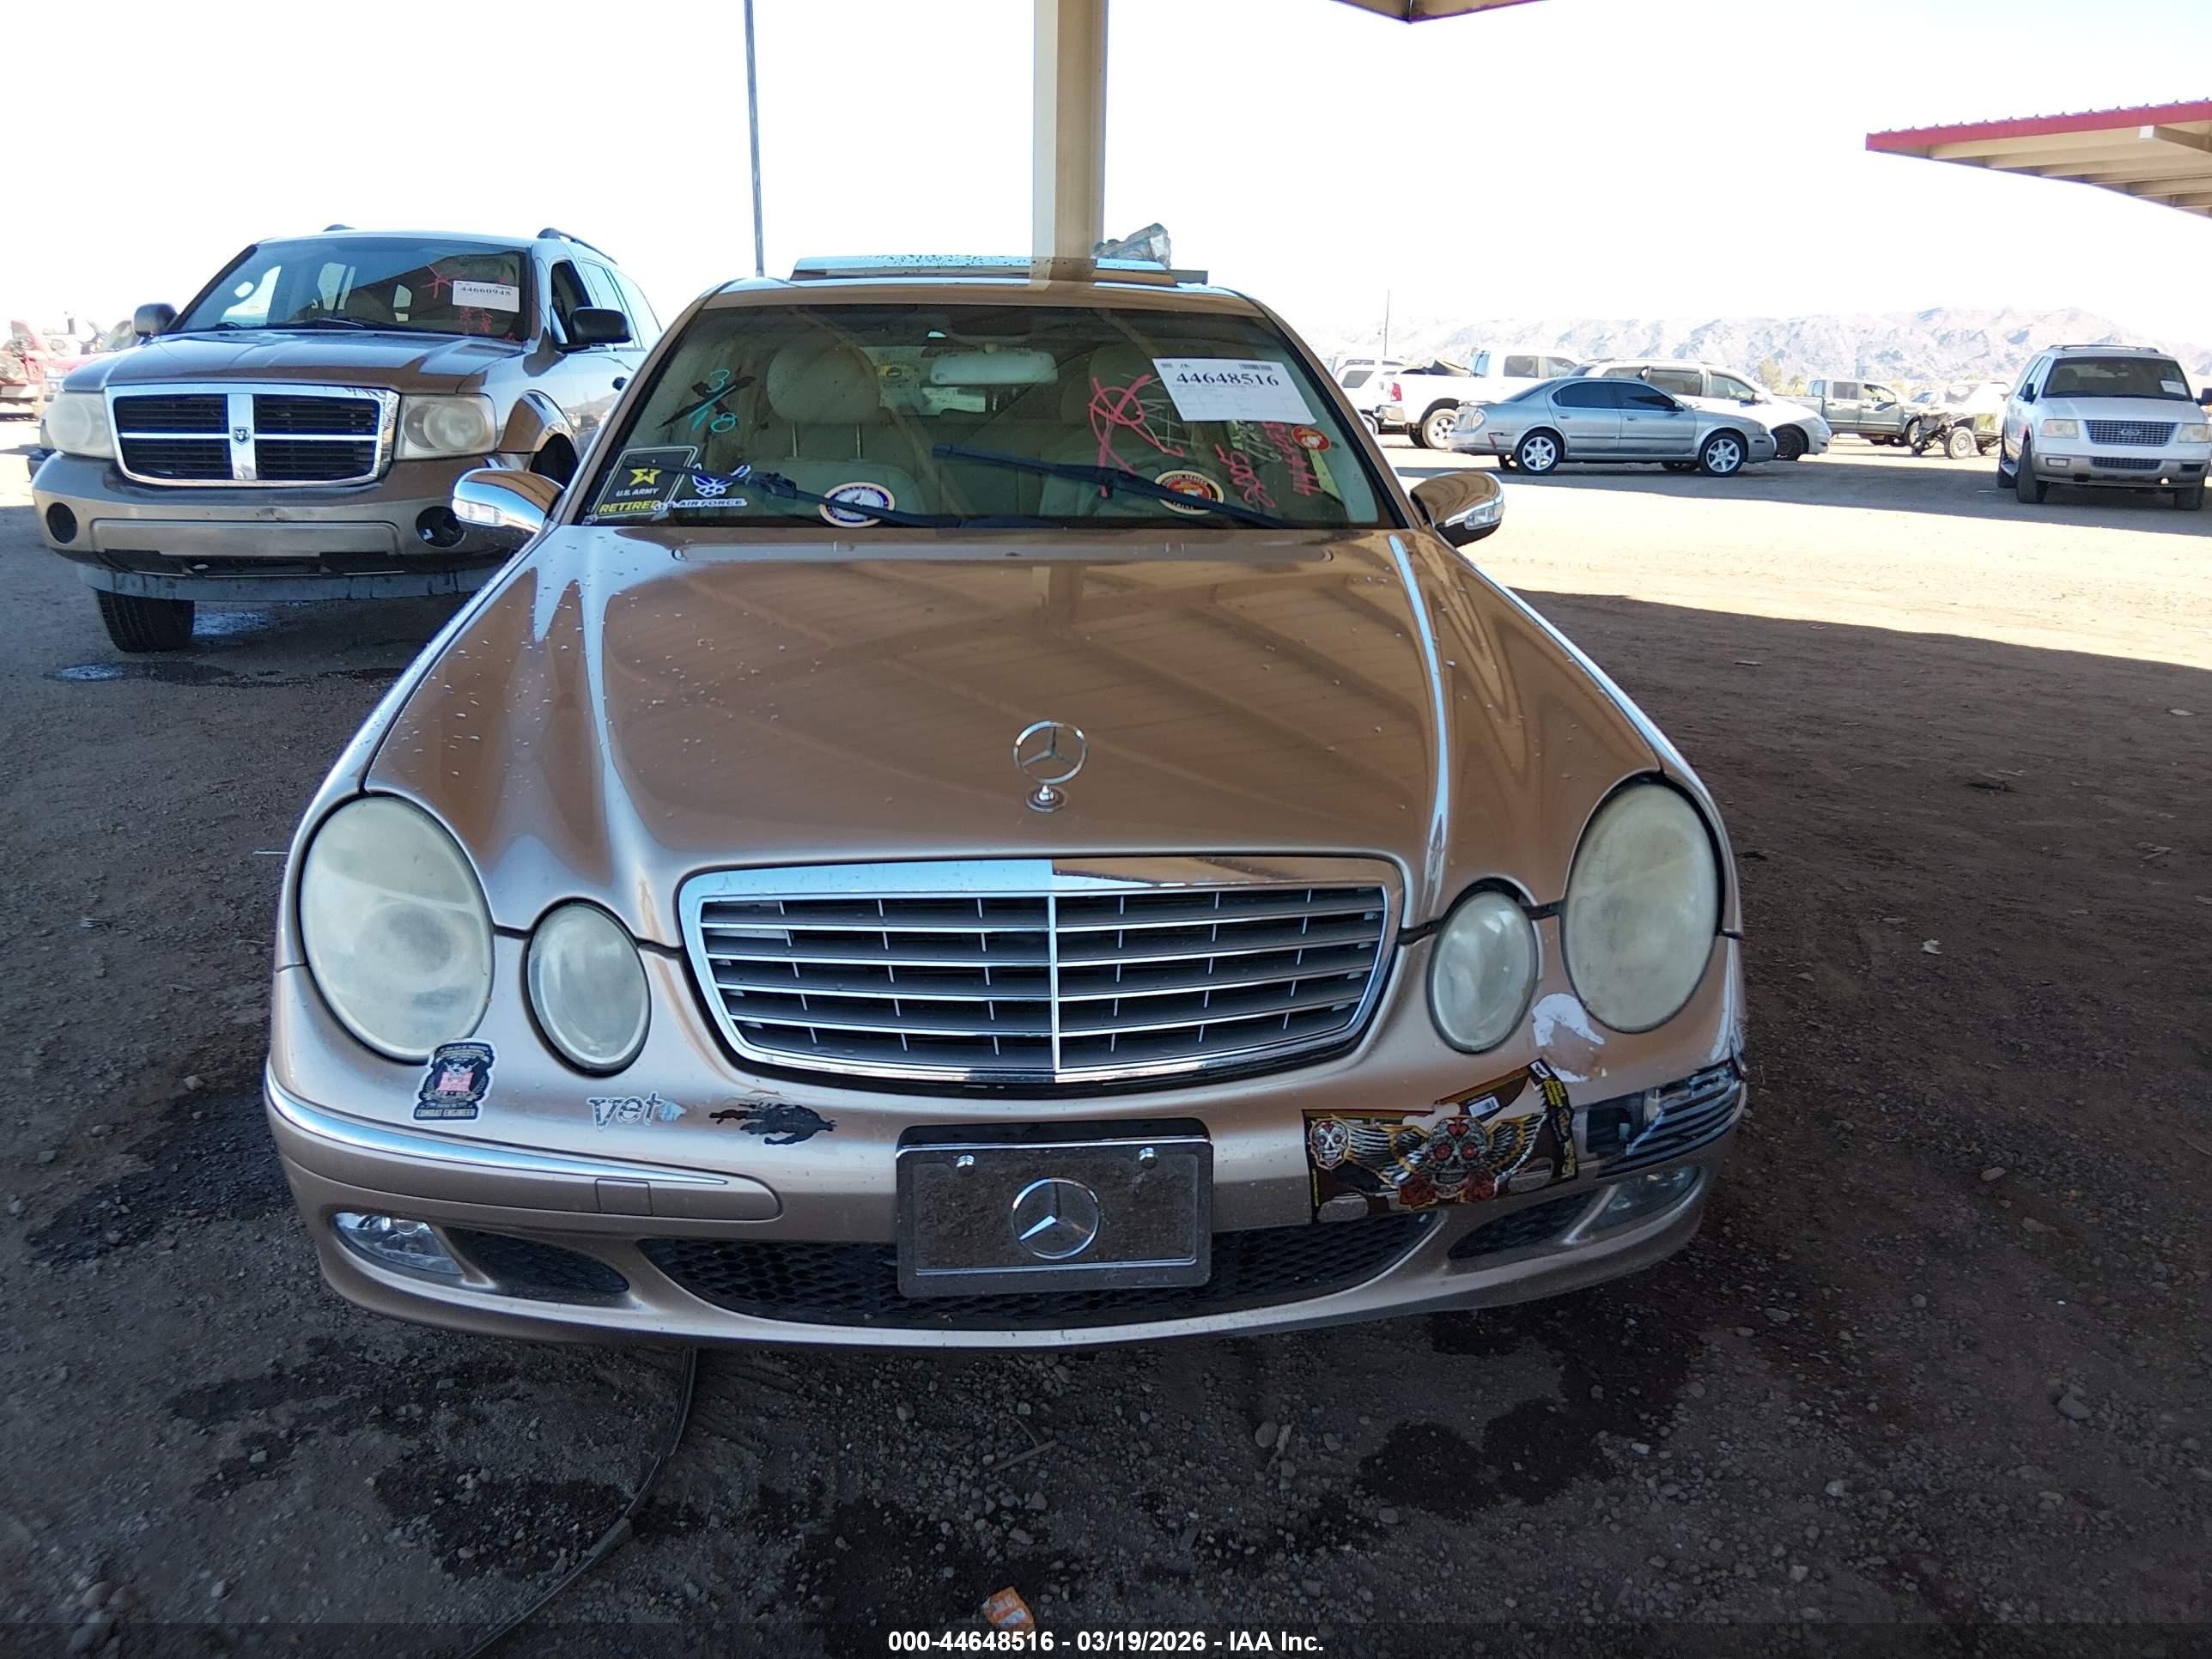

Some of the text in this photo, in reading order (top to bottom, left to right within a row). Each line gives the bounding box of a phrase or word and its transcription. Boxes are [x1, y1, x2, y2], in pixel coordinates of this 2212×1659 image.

[1176, 372, 1279, 387] 44648516
[616, 489, 631, 497] U.S.
[599, 500, 661, 514] RETIRED
[700, 499, 744, 507] FORCE
